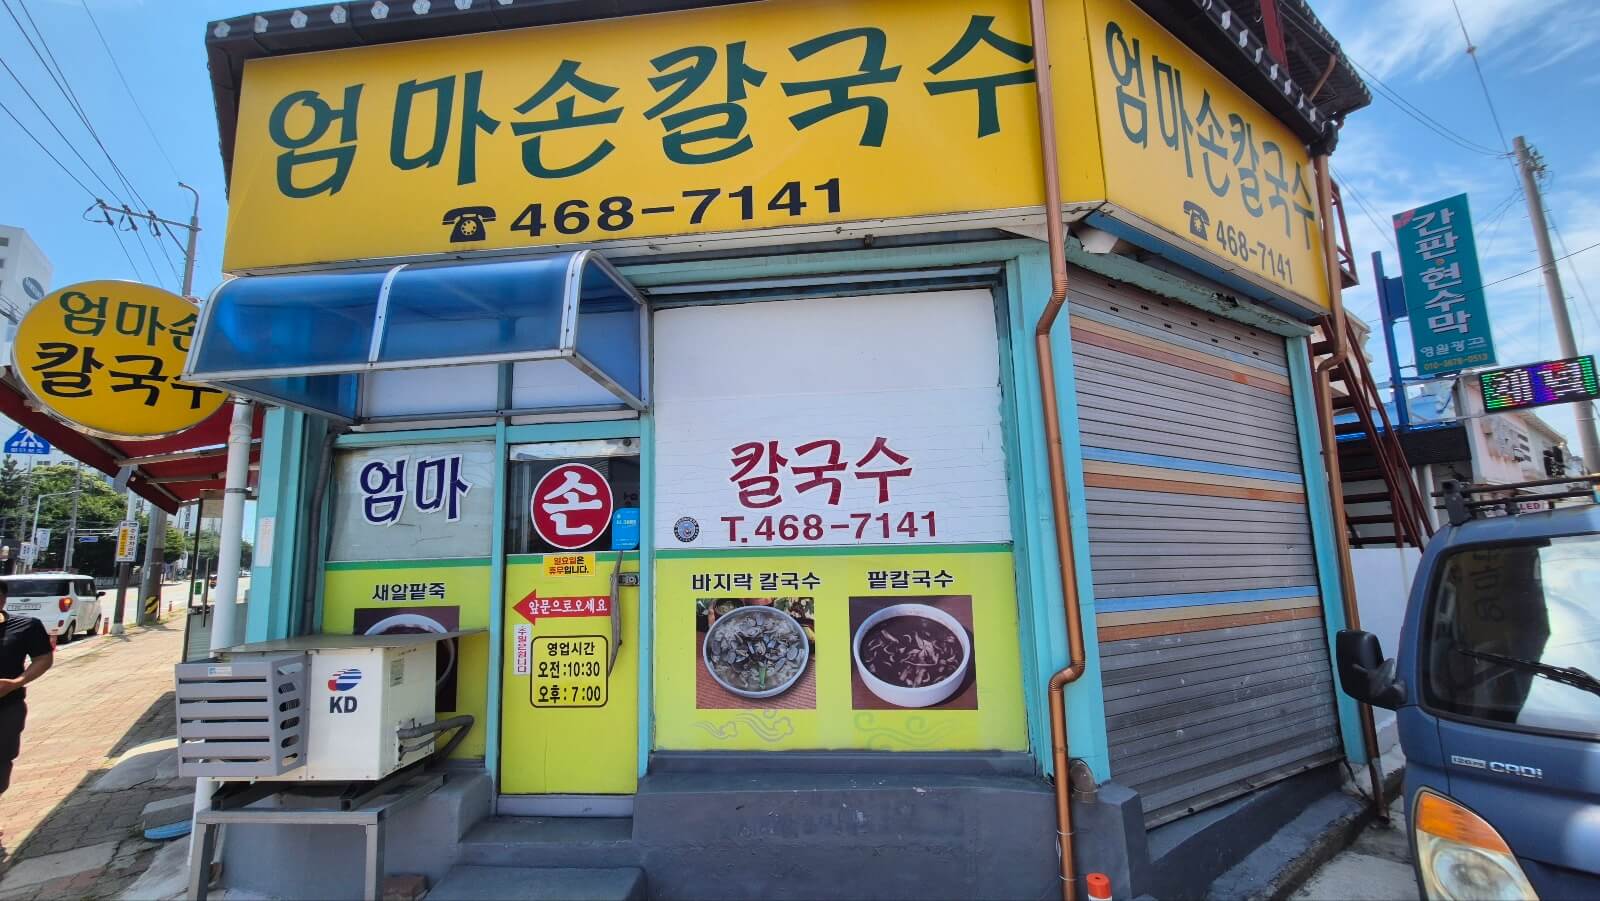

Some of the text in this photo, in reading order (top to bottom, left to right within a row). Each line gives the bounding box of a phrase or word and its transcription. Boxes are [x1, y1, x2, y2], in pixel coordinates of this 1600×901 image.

[510, 178, 841, 237] 468-7141
[1217, 220, 1293, 285] 468-7141
[730, 436, 913, 508] 칼국수
[359, 454, 472, 526] 엄마
[542, 470, 603, 536] 손
[1519, 502, 1541, 511] LED
[721, 511, 937, 544] T.468-7141
[549, 565, 589, 575] 휴무입니다.
[553, 556, 584, 564] 일요일은
[692, 572, 821, 591] 바지락 칼국수
[868, 568, 954, 589] 팥칼국수
[372, 581, 445, 601] 새알팥죽
[547, 642, 595, 656] 영업시간
[329, 696, 357, 713] KD
[1489, 761, 1543, 779] CRDi
